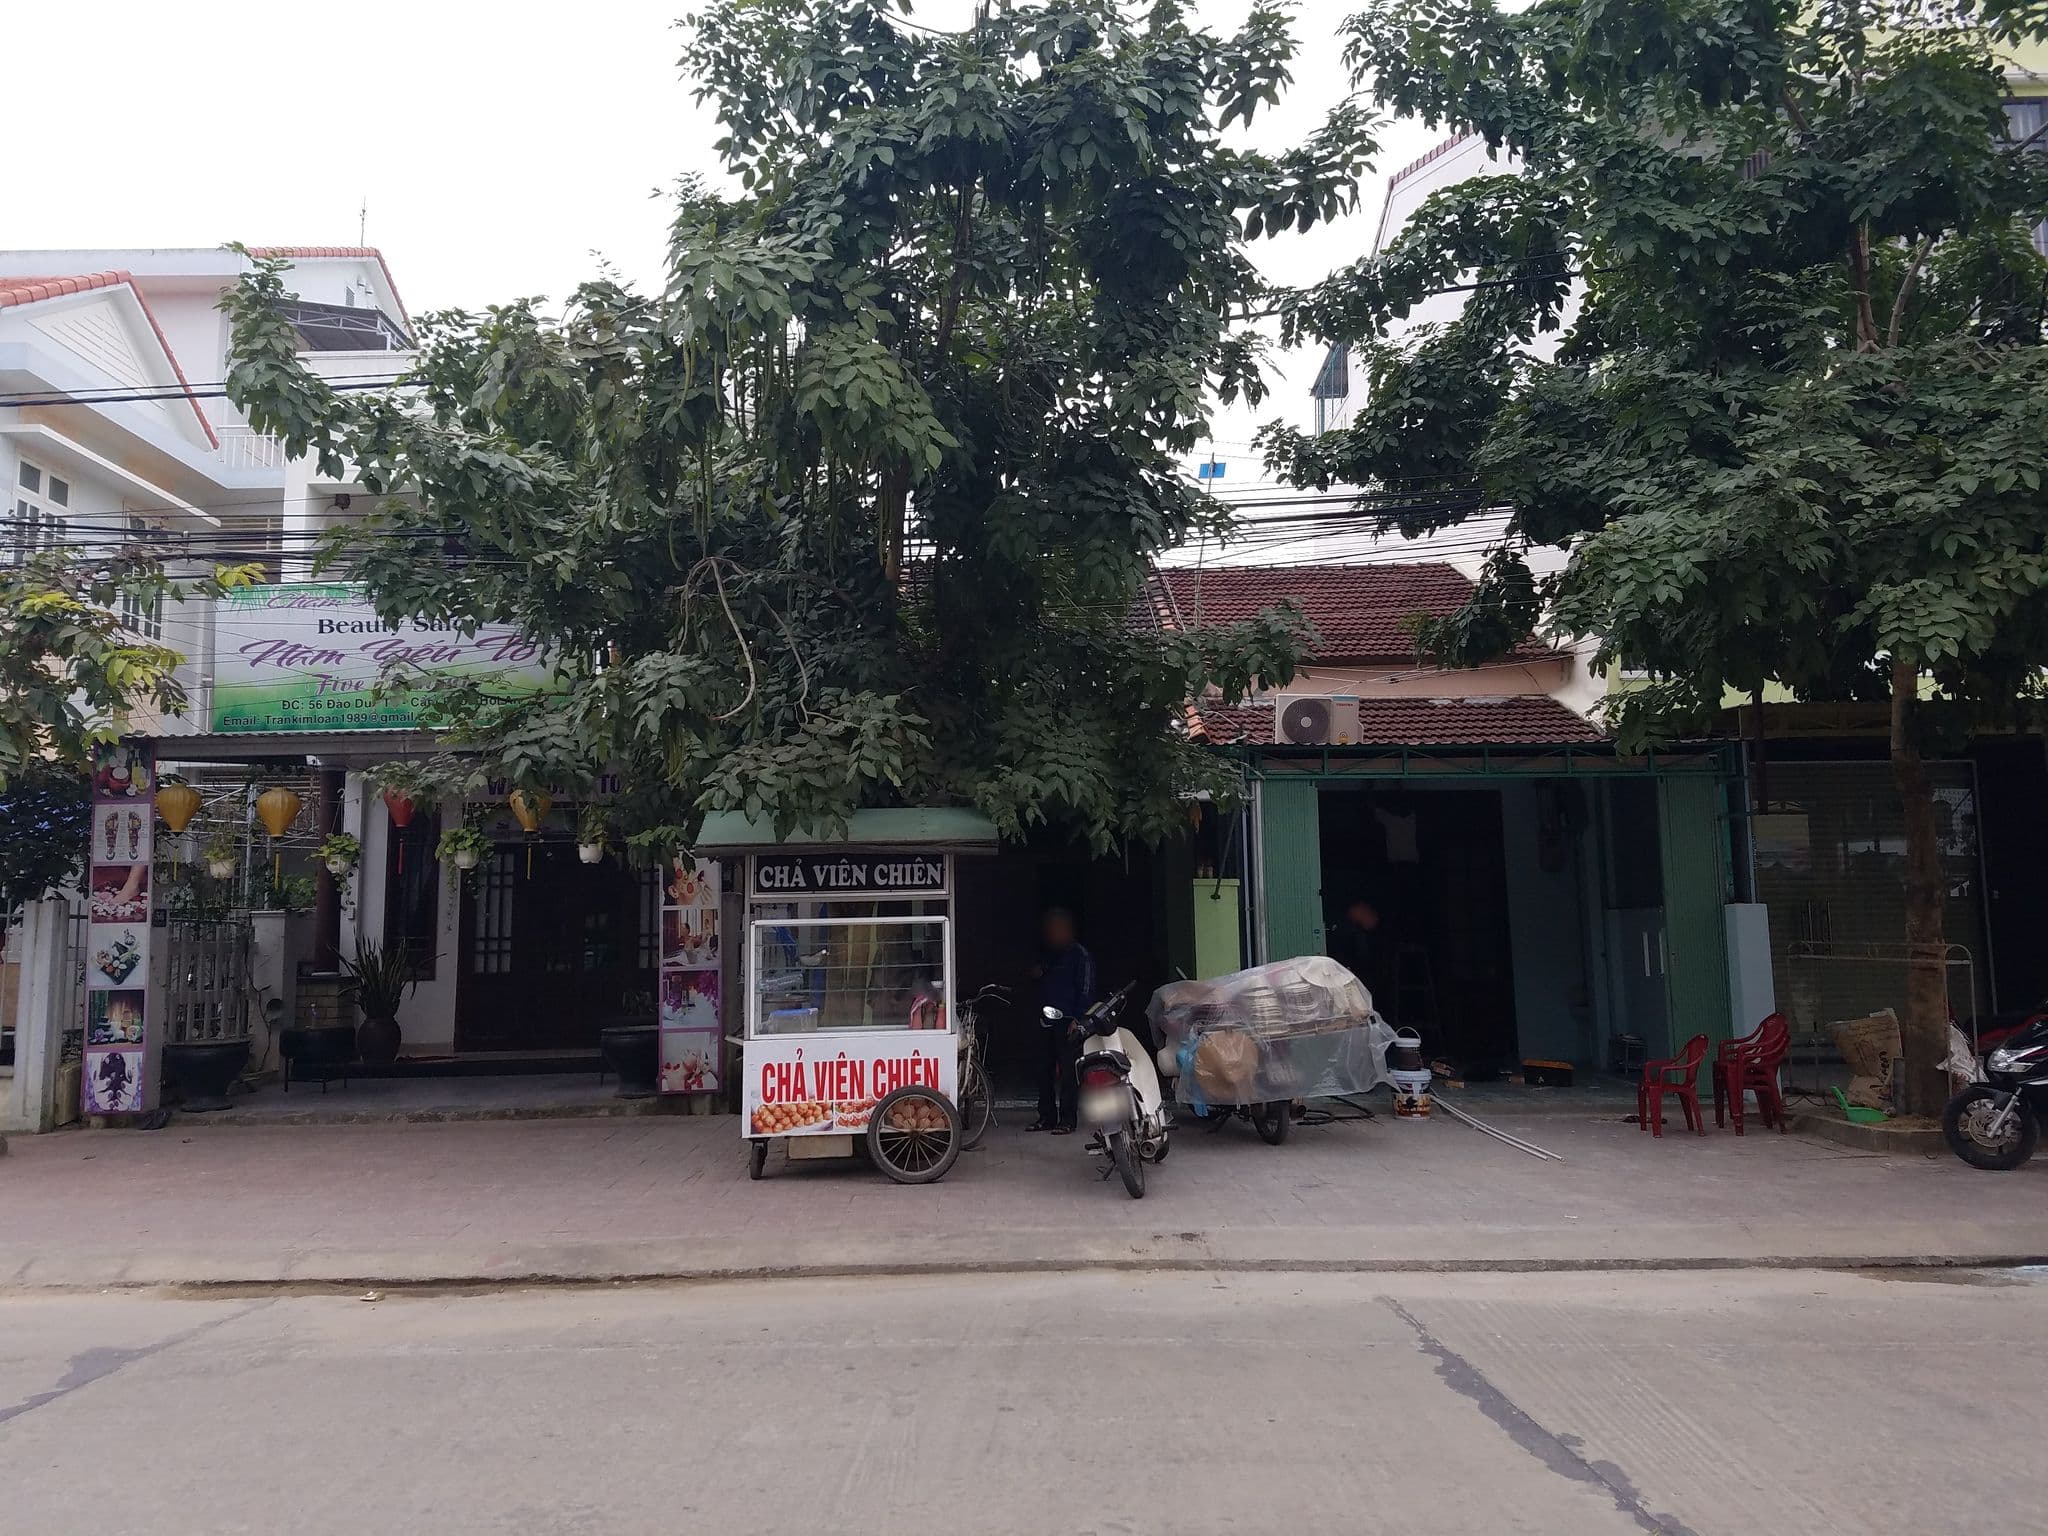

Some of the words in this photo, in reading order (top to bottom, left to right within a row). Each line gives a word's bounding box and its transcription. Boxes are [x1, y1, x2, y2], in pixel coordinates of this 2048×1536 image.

[312, 673, 365, 696] Five
[282, 699, 304, 710] ĐC:
[308, 700, 323, 710] 56
[759, 858, 807, 888] CHẢ
[813, 858, 868, 887] VIÊN
[873, 856, 942, 886] CHIÊN
[762, 1047, 807, 1103] CHẢ
[813, 1052, 865, 1101] VIÊN
[873, 1049, 939, 1100] CHIÊN
